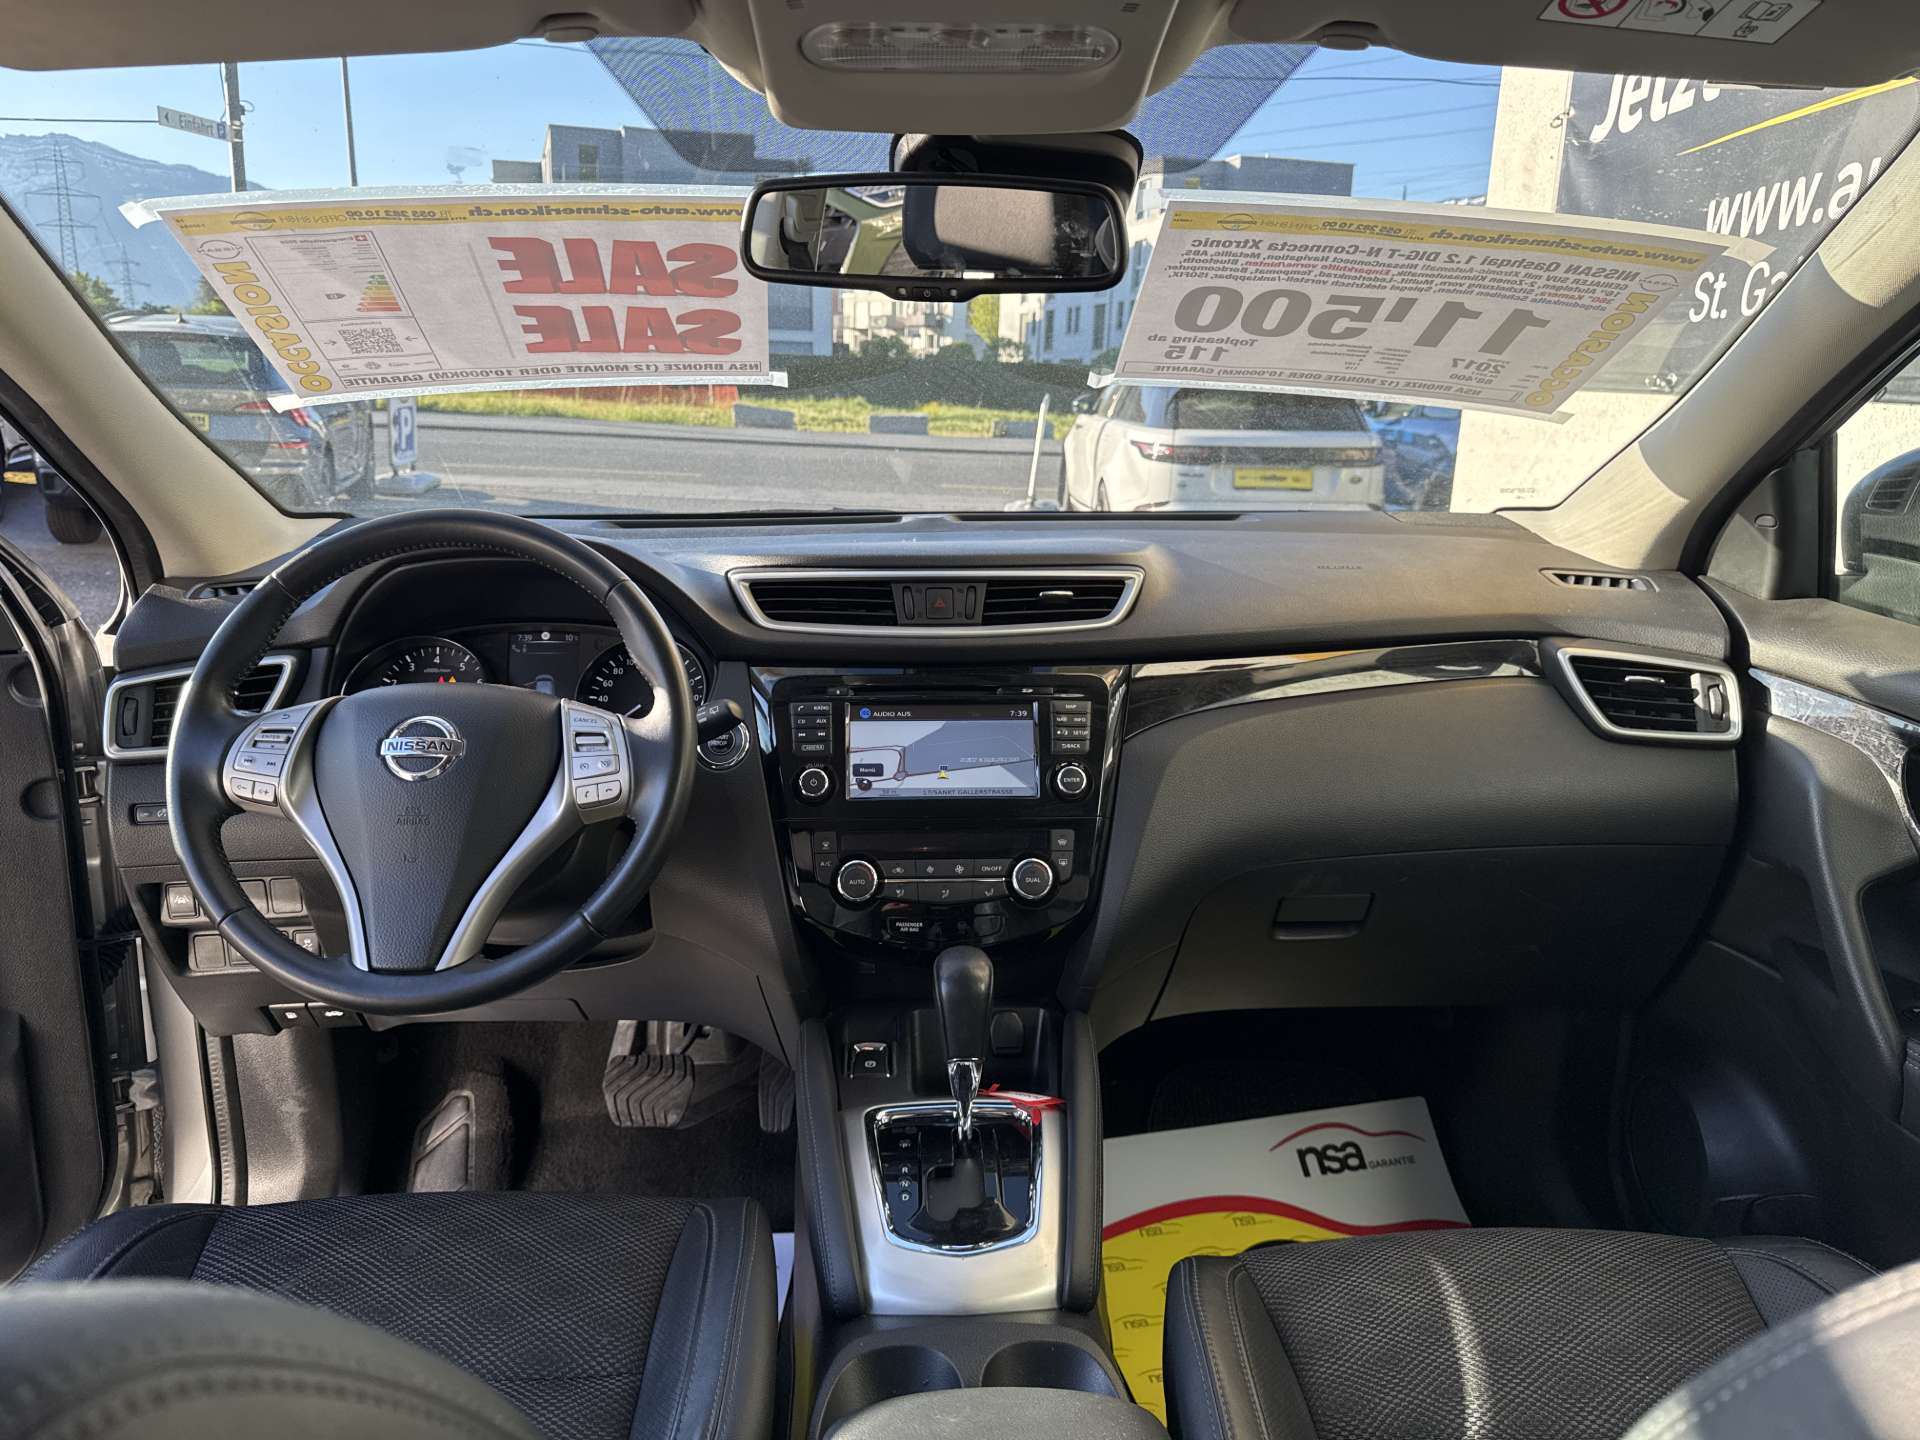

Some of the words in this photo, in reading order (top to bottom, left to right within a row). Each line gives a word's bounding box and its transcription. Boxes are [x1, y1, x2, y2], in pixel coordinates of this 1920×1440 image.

[178, 113, 214, 137] Einfahrt
[1689, 271, 1727, 322] St.
[398, 410, 413, 452] P
[433, 655, 441, 664] 4
[408, 663, 416, 672] 3
[458, 662, 467, 672] 5
[612, 667, 624, 676] 80
[602, 679, 614, 688] 60
[597, 695, 609, 703] 40
[387, 738, 454, 753] NISSAN
[1296, 1140, 1368, 1178] nsa
[1368, 1154, 1417, 1169] GARANTIE
[1231, 1215, 1257, 1228] nsa
[1137, 1226, 1163, 1239] nsa
[1122, 1318, 1150, 1330] nsa
